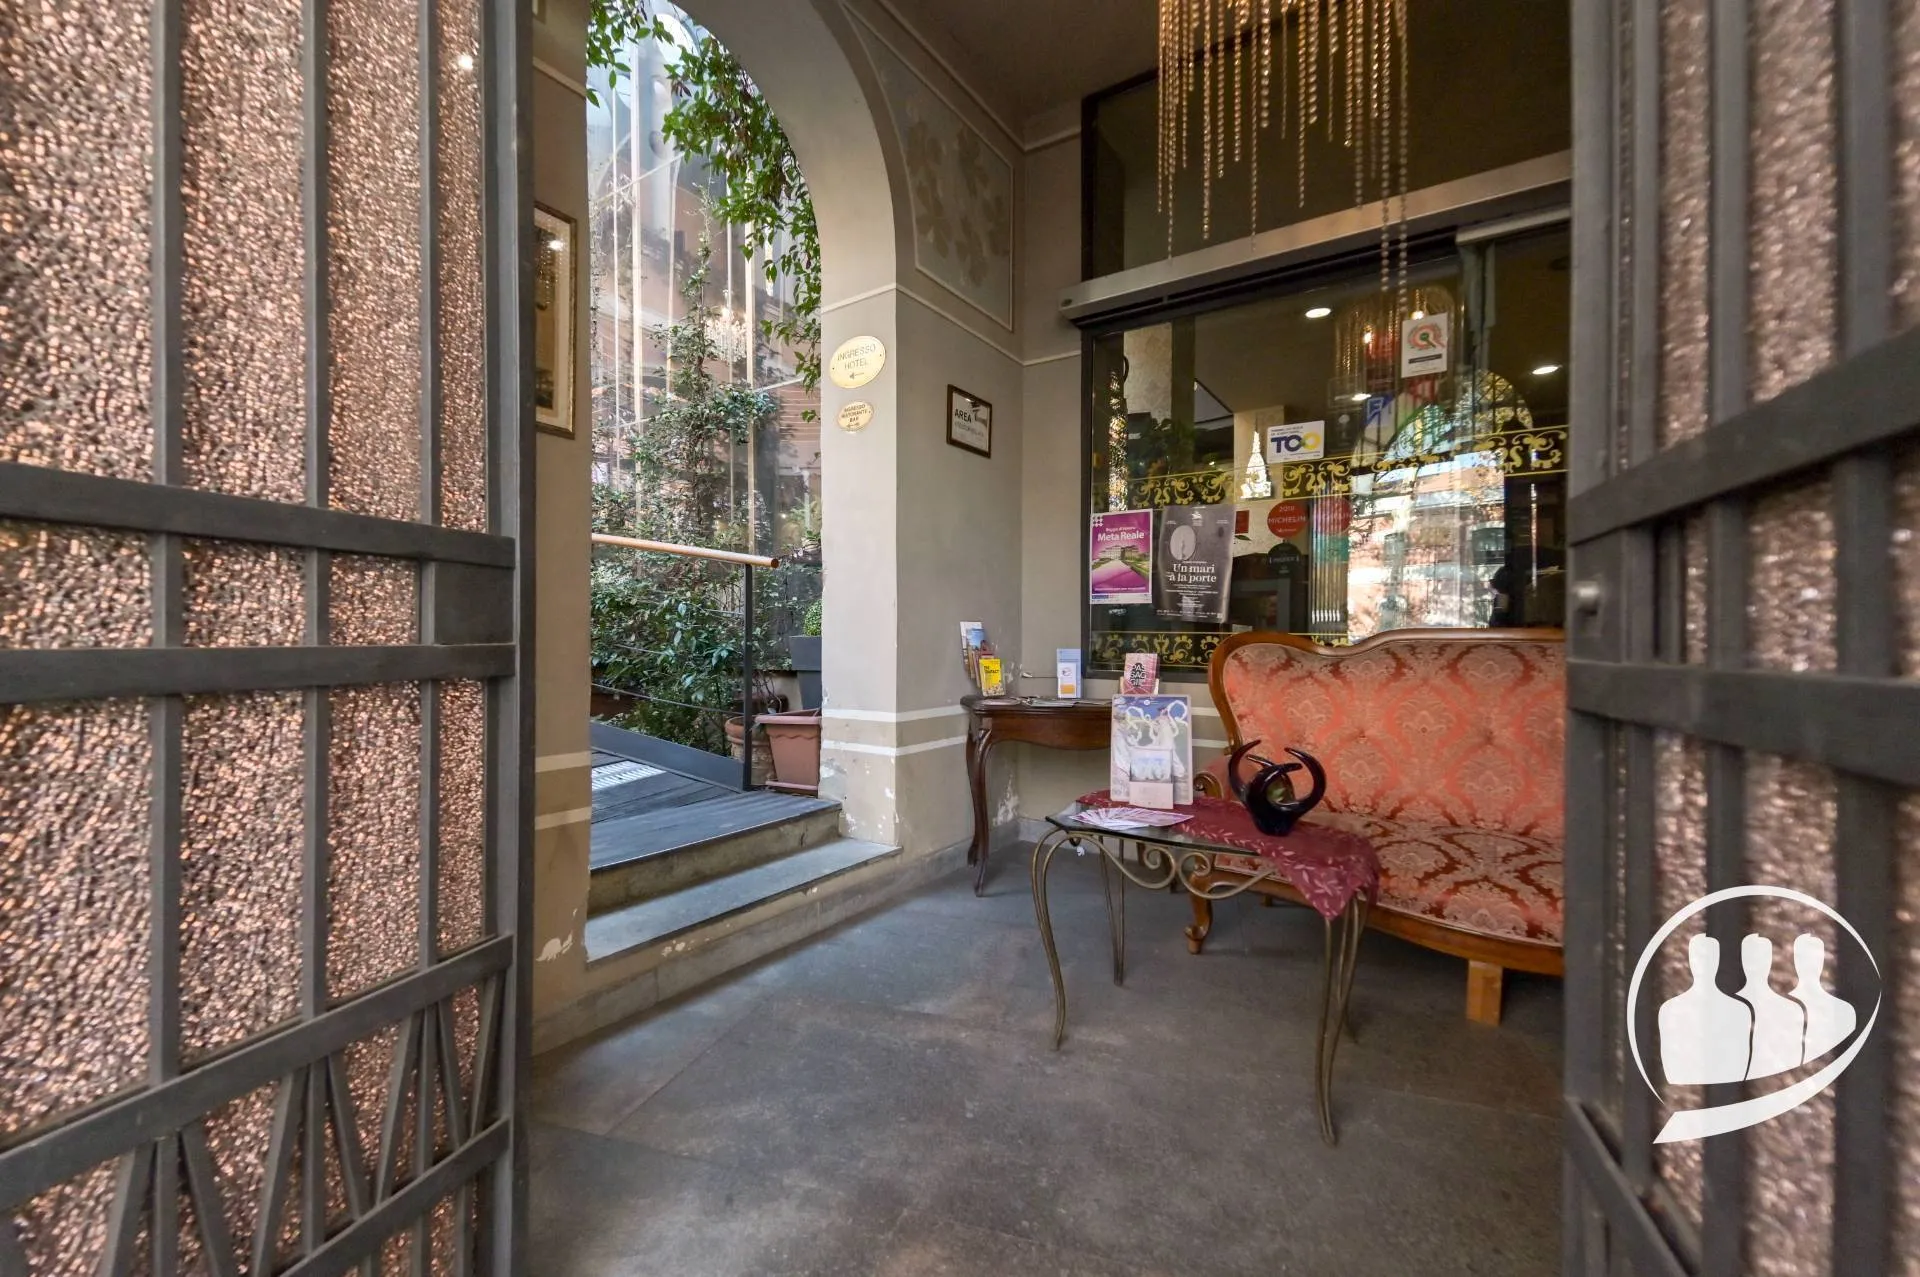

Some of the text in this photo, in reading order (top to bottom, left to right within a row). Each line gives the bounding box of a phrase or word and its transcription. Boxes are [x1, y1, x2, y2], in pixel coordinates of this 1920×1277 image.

[837, 343, 876, 361] INGRESSO
[844, 358, 867, 370] HOTEL
[954, 408, 972, 423] AREA
[1268, 515, 1306, 524] MICHELIN
[1097, 530, 1145, 542] Meta Reale
[1173, 563, 1215, 573] Un mari
[1177, 573, 1187, 582] la
[1188, 574, 1217, 583] porte
